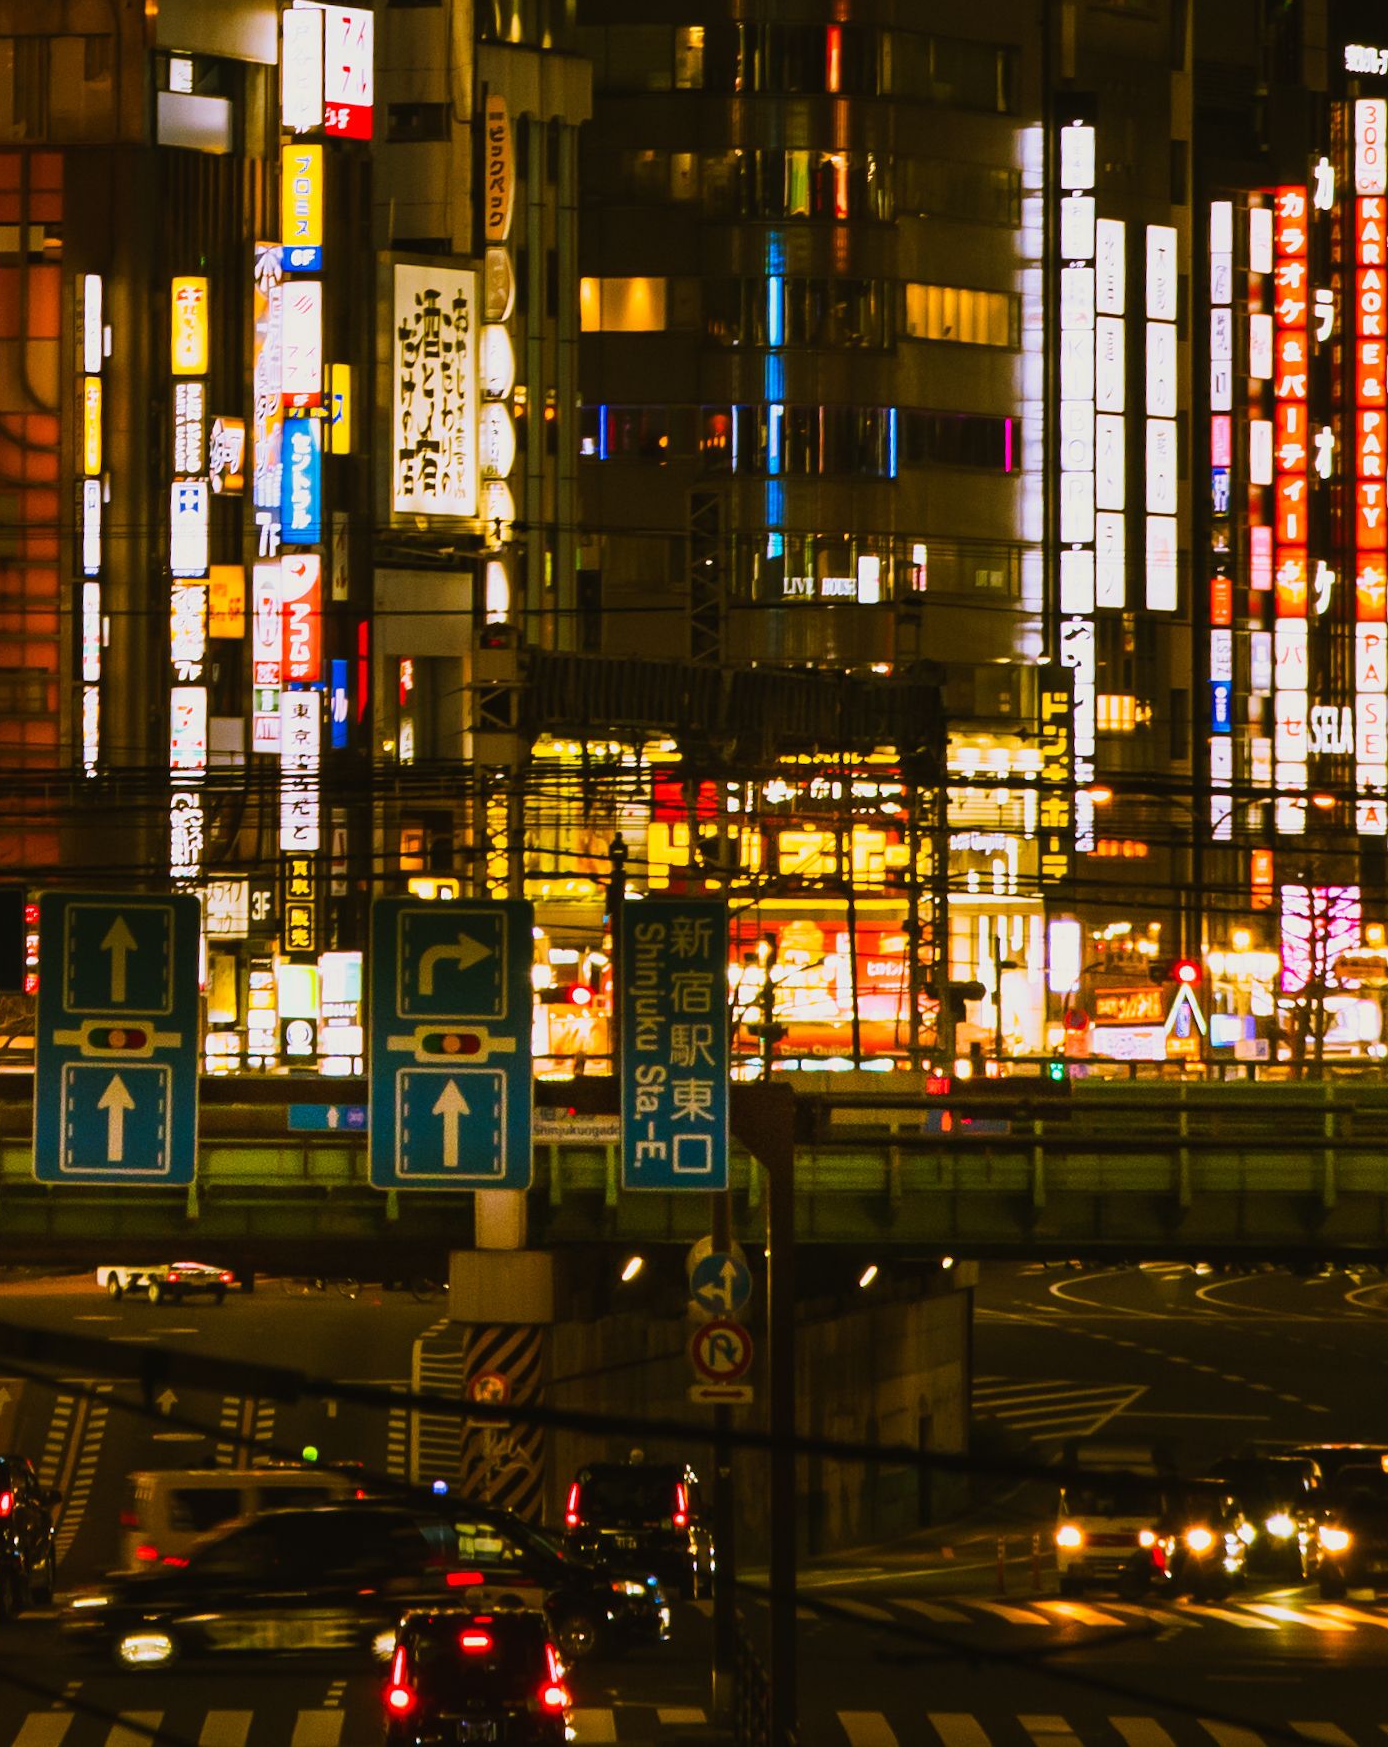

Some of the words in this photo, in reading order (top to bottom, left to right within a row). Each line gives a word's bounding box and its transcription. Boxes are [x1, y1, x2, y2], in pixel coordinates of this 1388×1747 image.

[1362, 105, 1379, 166] 300
[294, 155, 311, 236] プロミス
[1361, 197, 1382, 366] KARAOKE
[1362, 380, 1380, 397] &
[1361, 412, 1382, 528] PARTY
[256, 511, 281, 557] 7F
[783, 576, 815, 595] LIVE
[289, 603, 311, 661] アコム
[252, 891, 272, 920] 3F
[633, 922, 664, 1051] Shinjuku
[668, 915, 715, 1174] 新宿駅東口
